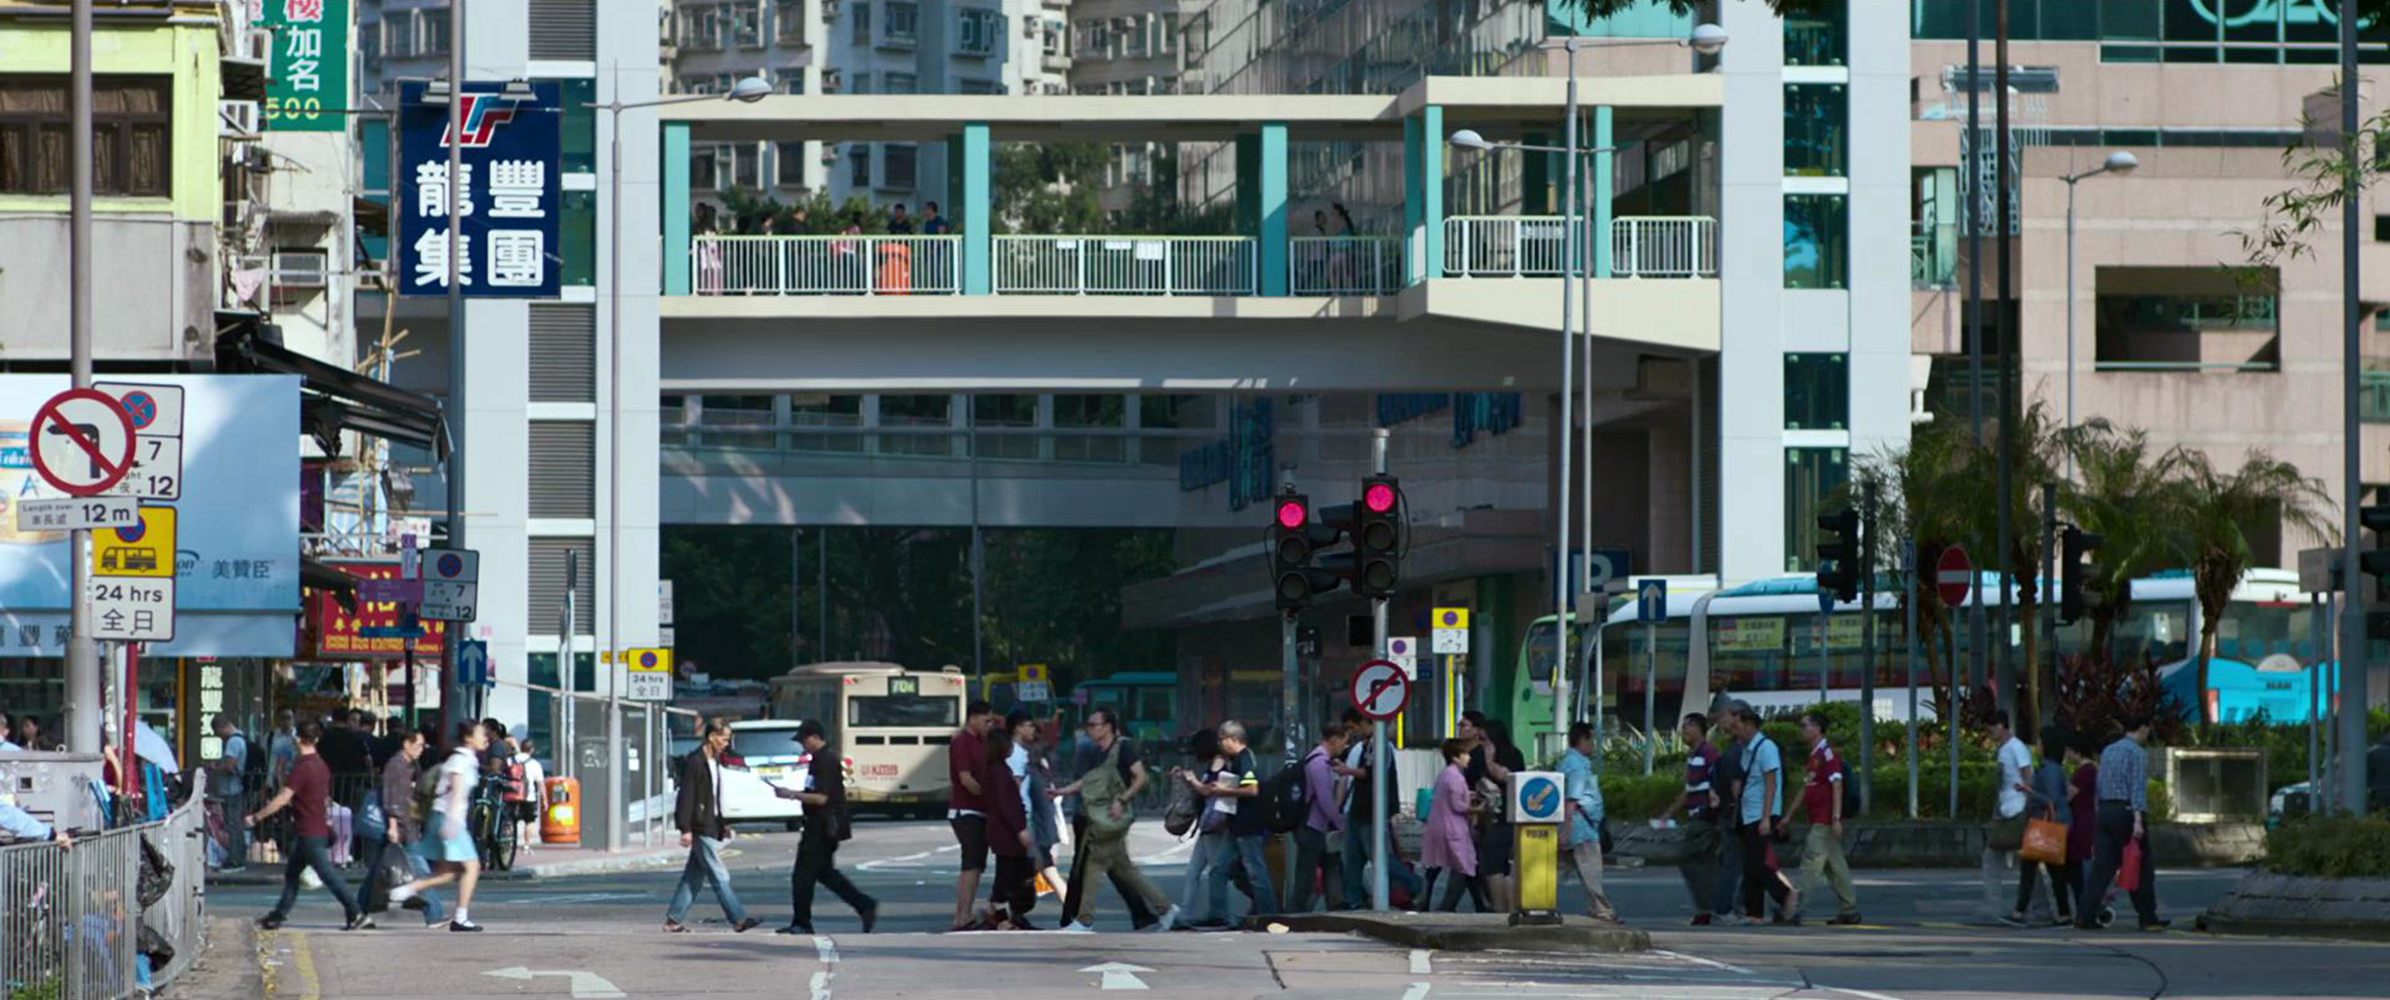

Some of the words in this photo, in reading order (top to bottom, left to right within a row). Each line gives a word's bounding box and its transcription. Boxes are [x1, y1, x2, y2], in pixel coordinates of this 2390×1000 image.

[416, 160, 546, 218] 龍豐
[414, 227, 544, 287] 集團
[148, 441, 162, 460] 7
[148, 475, 173, 495] 12
[82, 504, 107, 522] 12
[112, 508, 130, 521] m
[96, 584, 123, 601] 24
[130, 585, 163, 602] hrs
[457, 584, 465, 597] 7
[101, 608, 153, 632] 全日
[455, 605, 472, 619] 12
